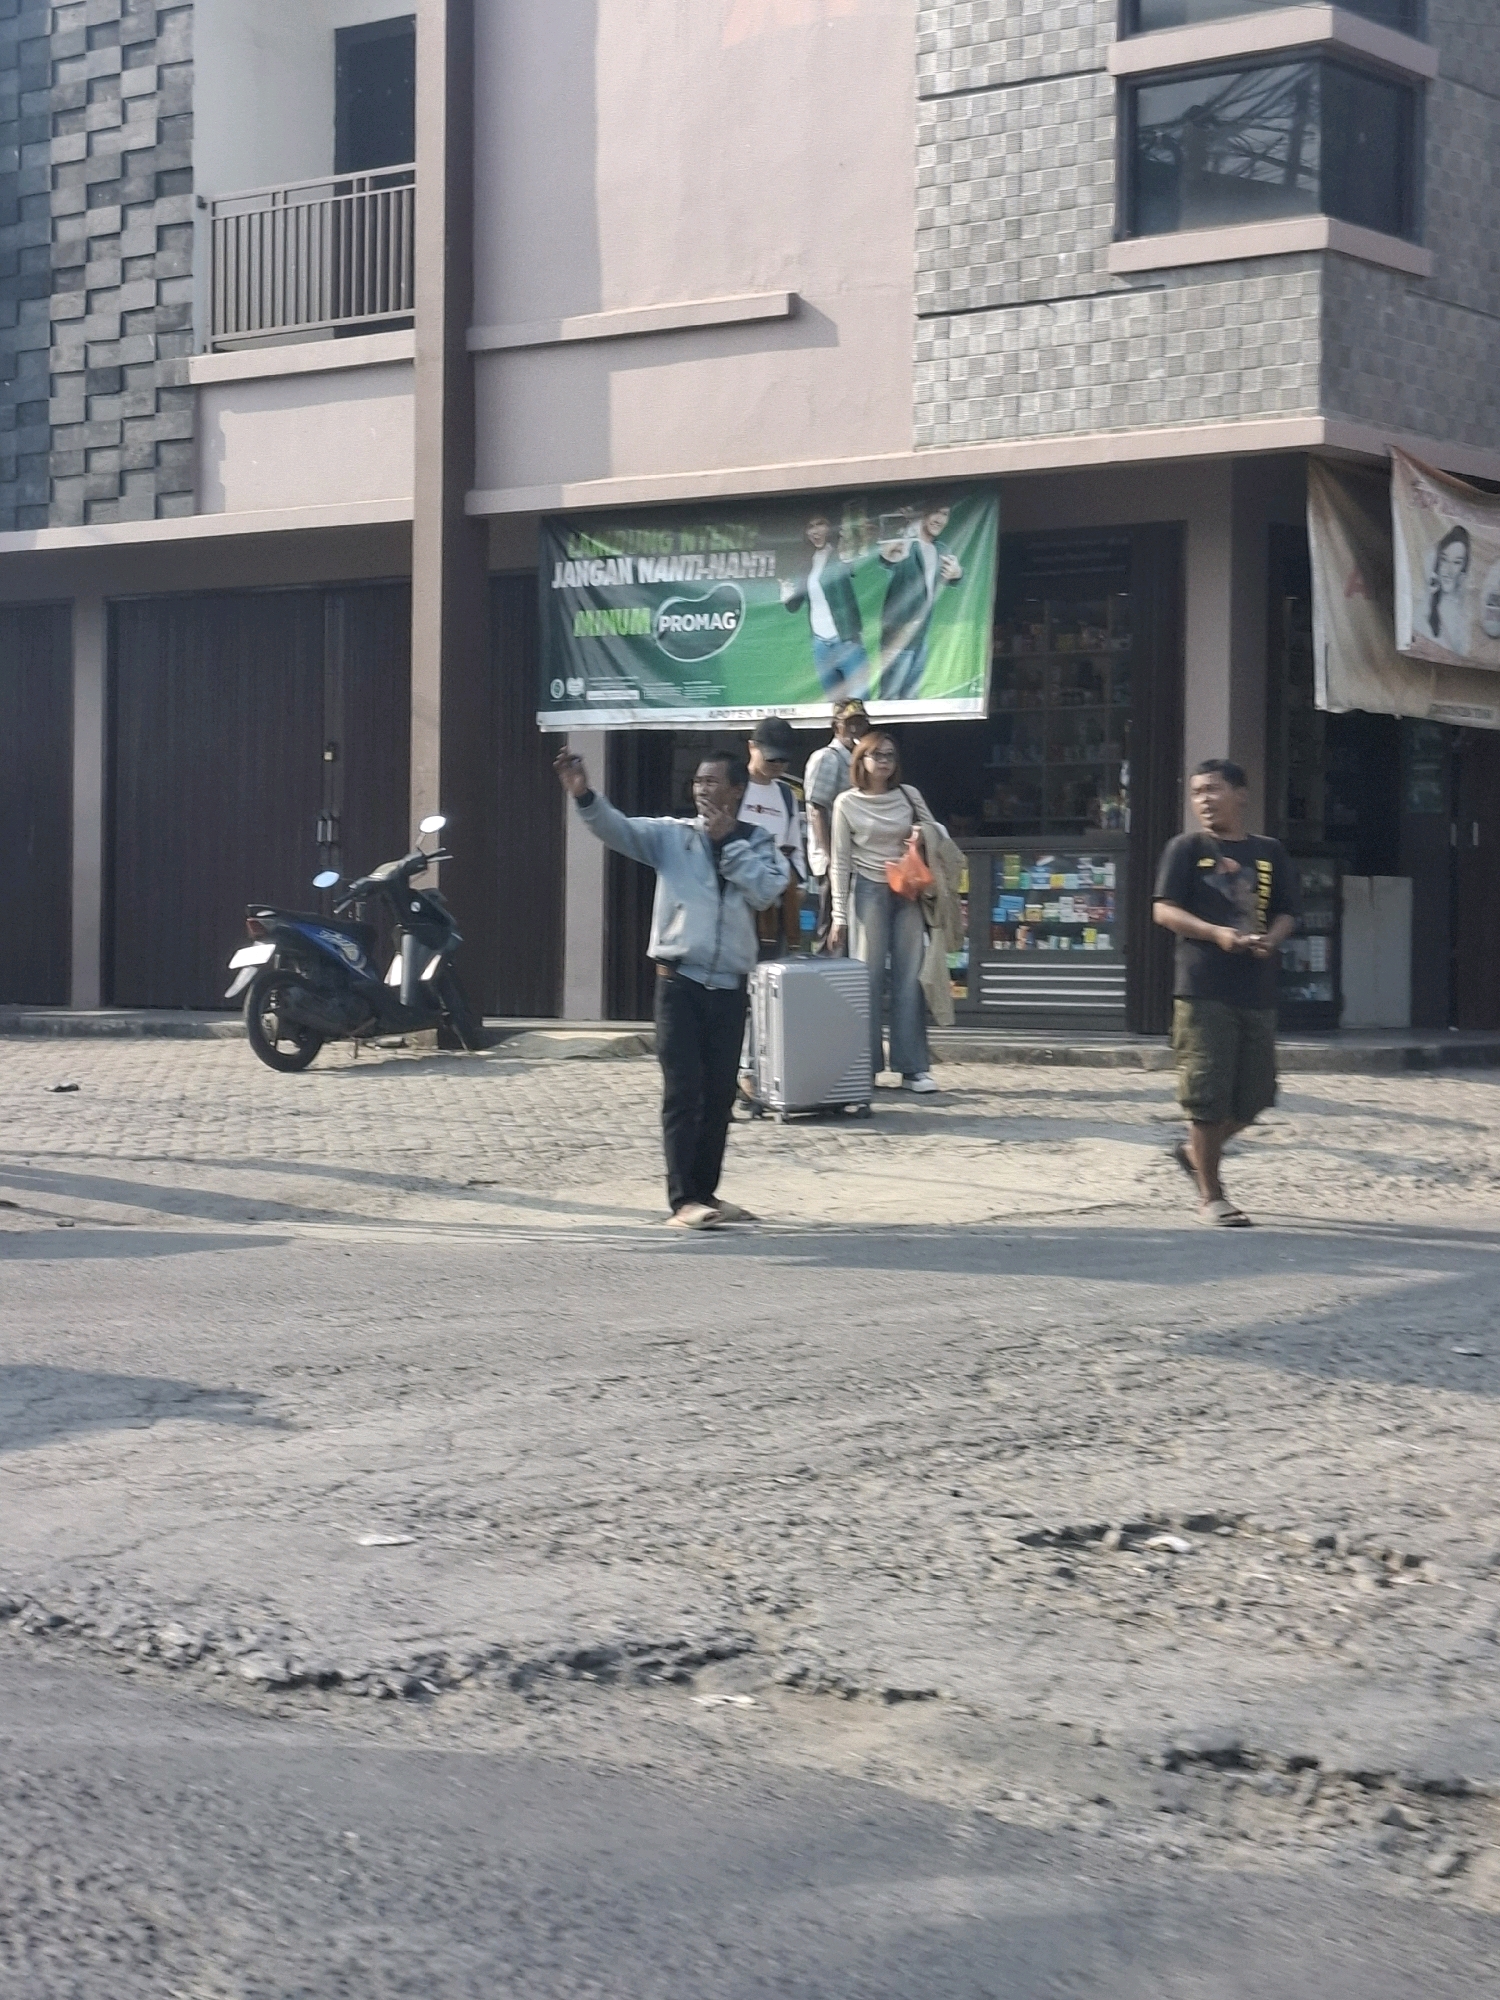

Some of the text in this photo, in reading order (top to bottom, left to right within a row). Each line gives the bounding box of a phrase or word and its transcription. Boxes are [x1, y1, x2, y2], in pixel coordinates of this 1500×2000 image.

[552, 557, 634, 588] JANGAN
[573, 608, 737, 637] MINUM PROMAG
